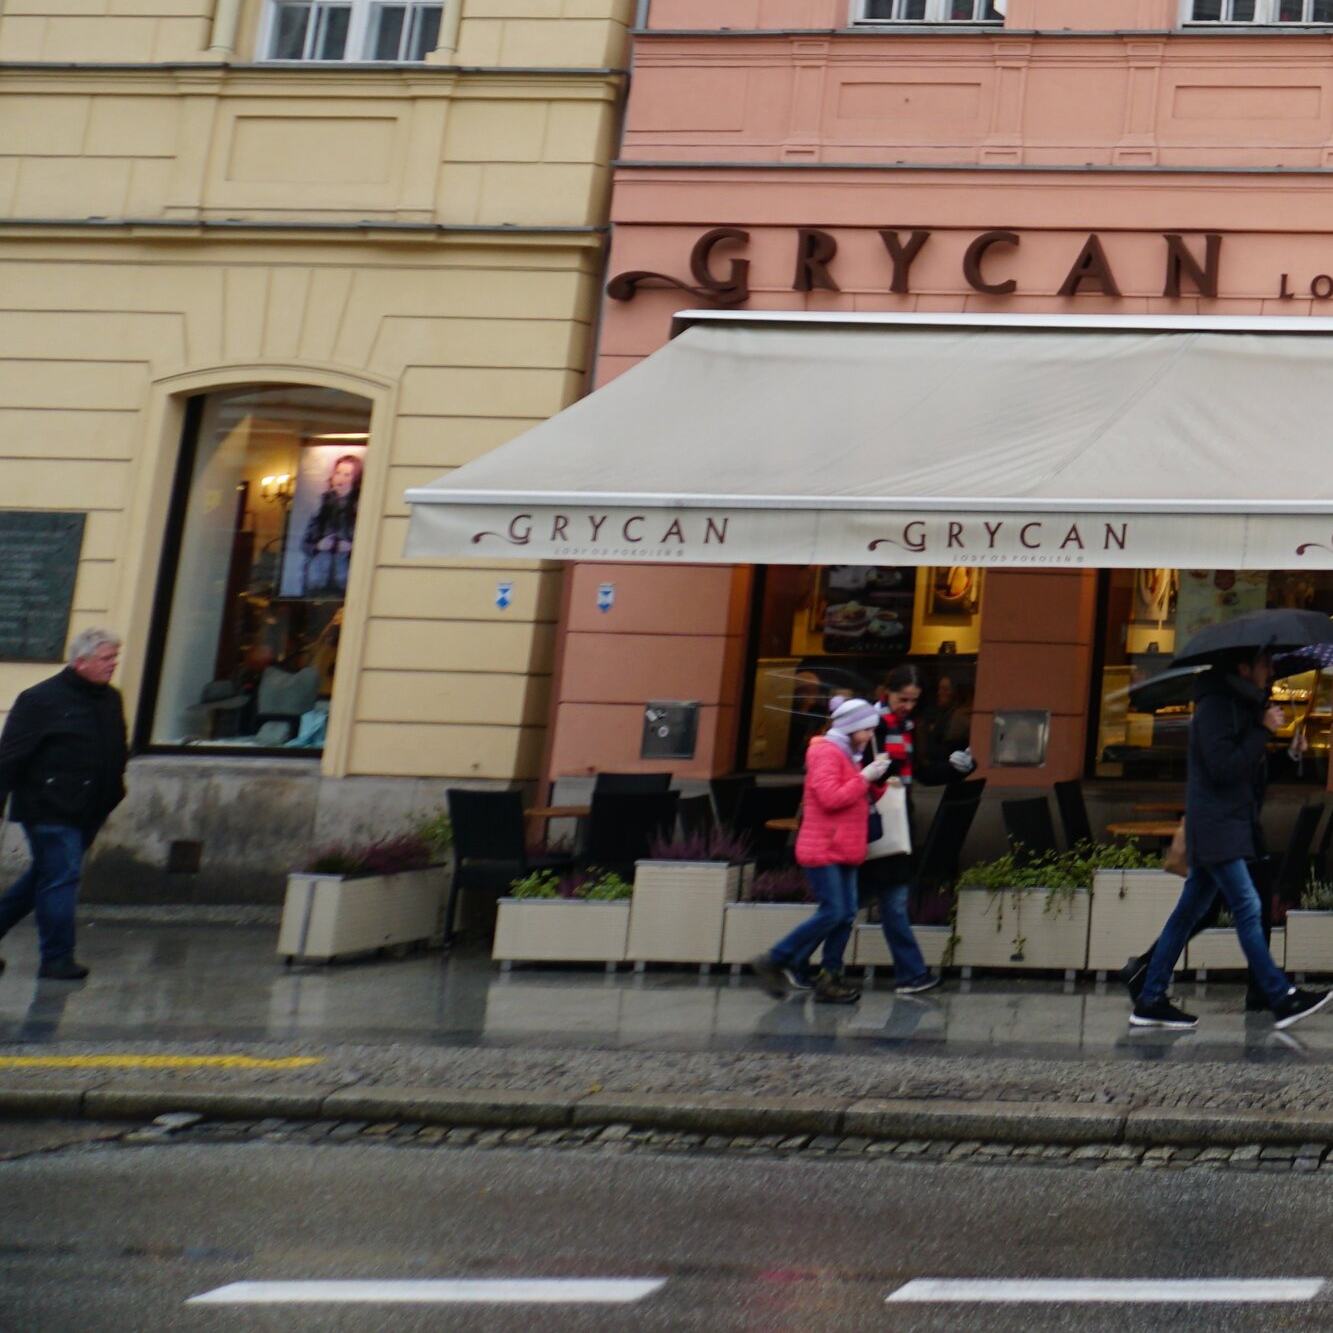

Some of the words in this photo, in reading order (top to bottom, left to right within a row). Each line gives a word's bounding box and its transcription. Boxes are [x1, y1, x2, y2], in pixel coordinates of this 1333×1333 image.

[606, 228, 1222, 304] GRYCAN
[471, 514, 730, 545] GRYCAN
[867, 521, 1128, 552] GRYCAN
